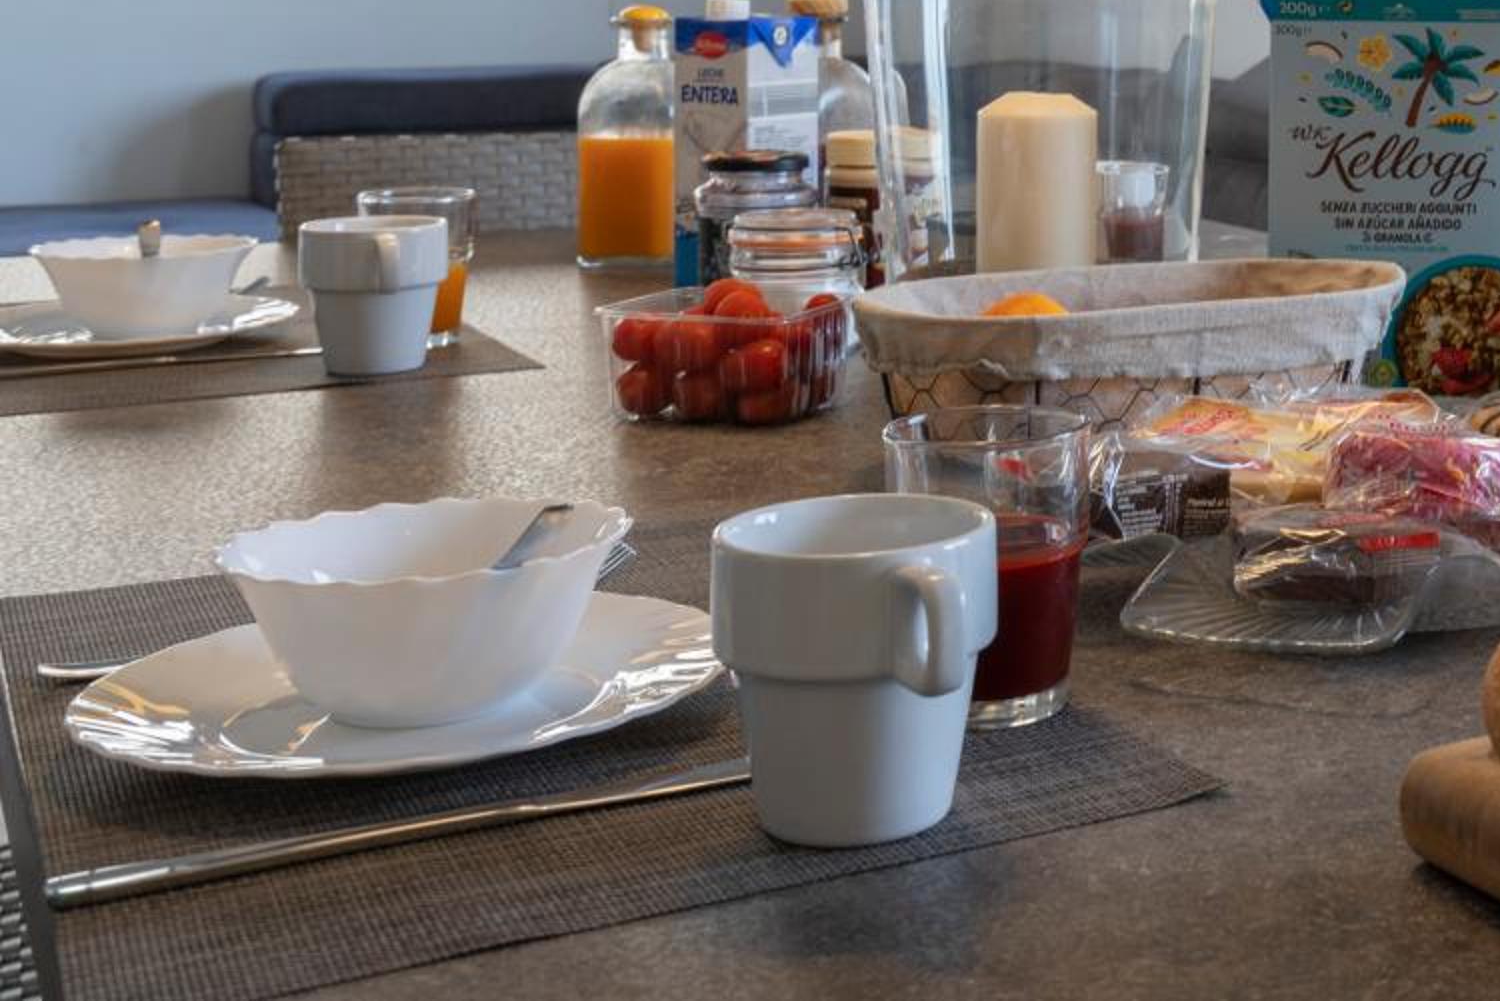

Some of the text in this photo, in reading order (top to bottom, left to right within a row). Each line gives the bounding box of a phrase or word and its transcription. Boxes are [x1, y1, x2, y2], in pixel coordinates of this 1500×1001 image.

[681, 84, 739, 105] ENTERA
[1305, 130, 1497, 201] Kellogg
[1320, 201, 1478, 216] SENZA ZUCCHERI AGGIUNTI
[1334, 214, 1462, 230] SIN AZÚCAR AÑADIDO
[1373, 232, 1421, 244] GRANOLA
